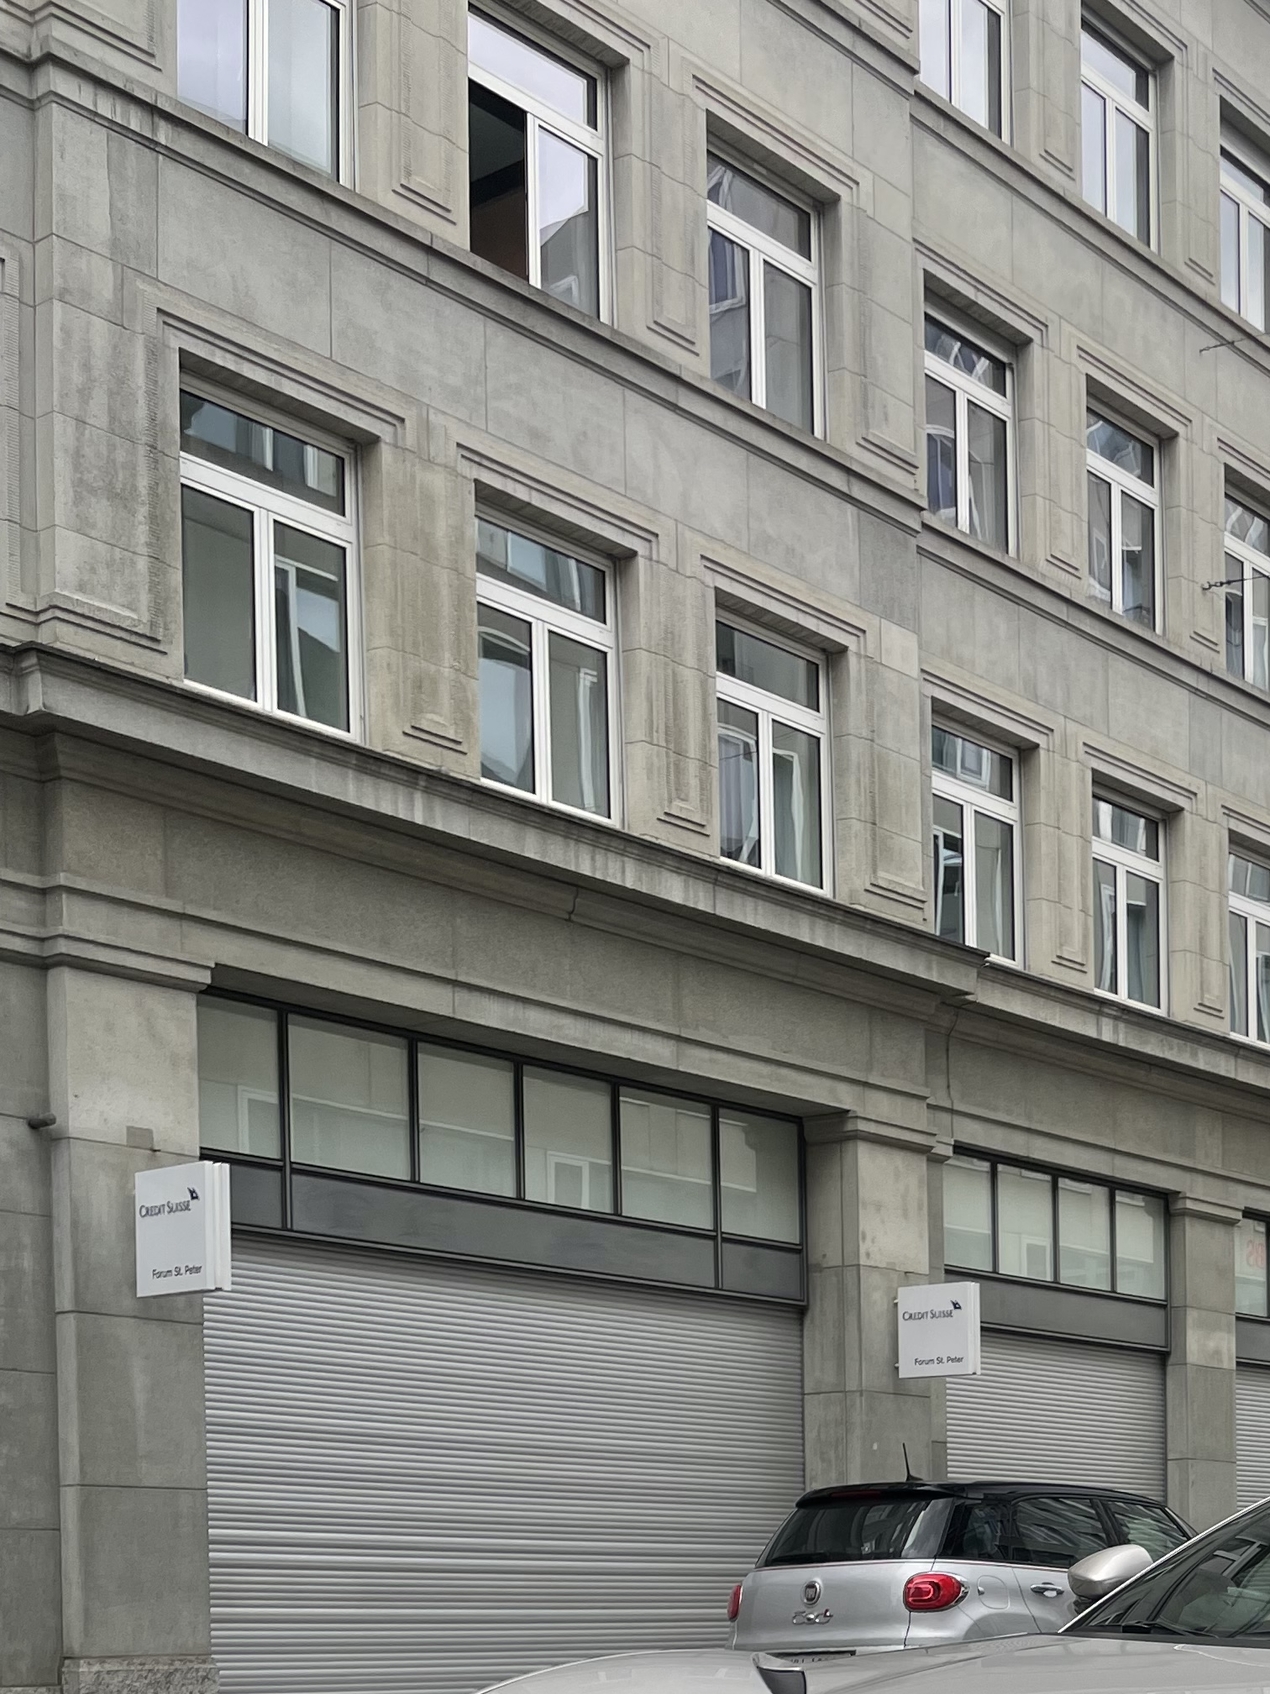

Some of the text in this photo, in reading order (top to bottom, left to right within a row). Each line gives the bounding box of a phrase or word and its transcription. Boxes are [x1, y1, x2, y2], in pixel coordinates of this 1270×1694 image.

[139, 1200, 191, 1218] CREDIT SUISSE
[152, 1265, 203, 1279] Forum St. Peter
[902, 1309, 954, 1321] CREDIT SUISSE
[914, 1357, 935, 1366] Forum
[946, 1355, 964, 1363] Peter
